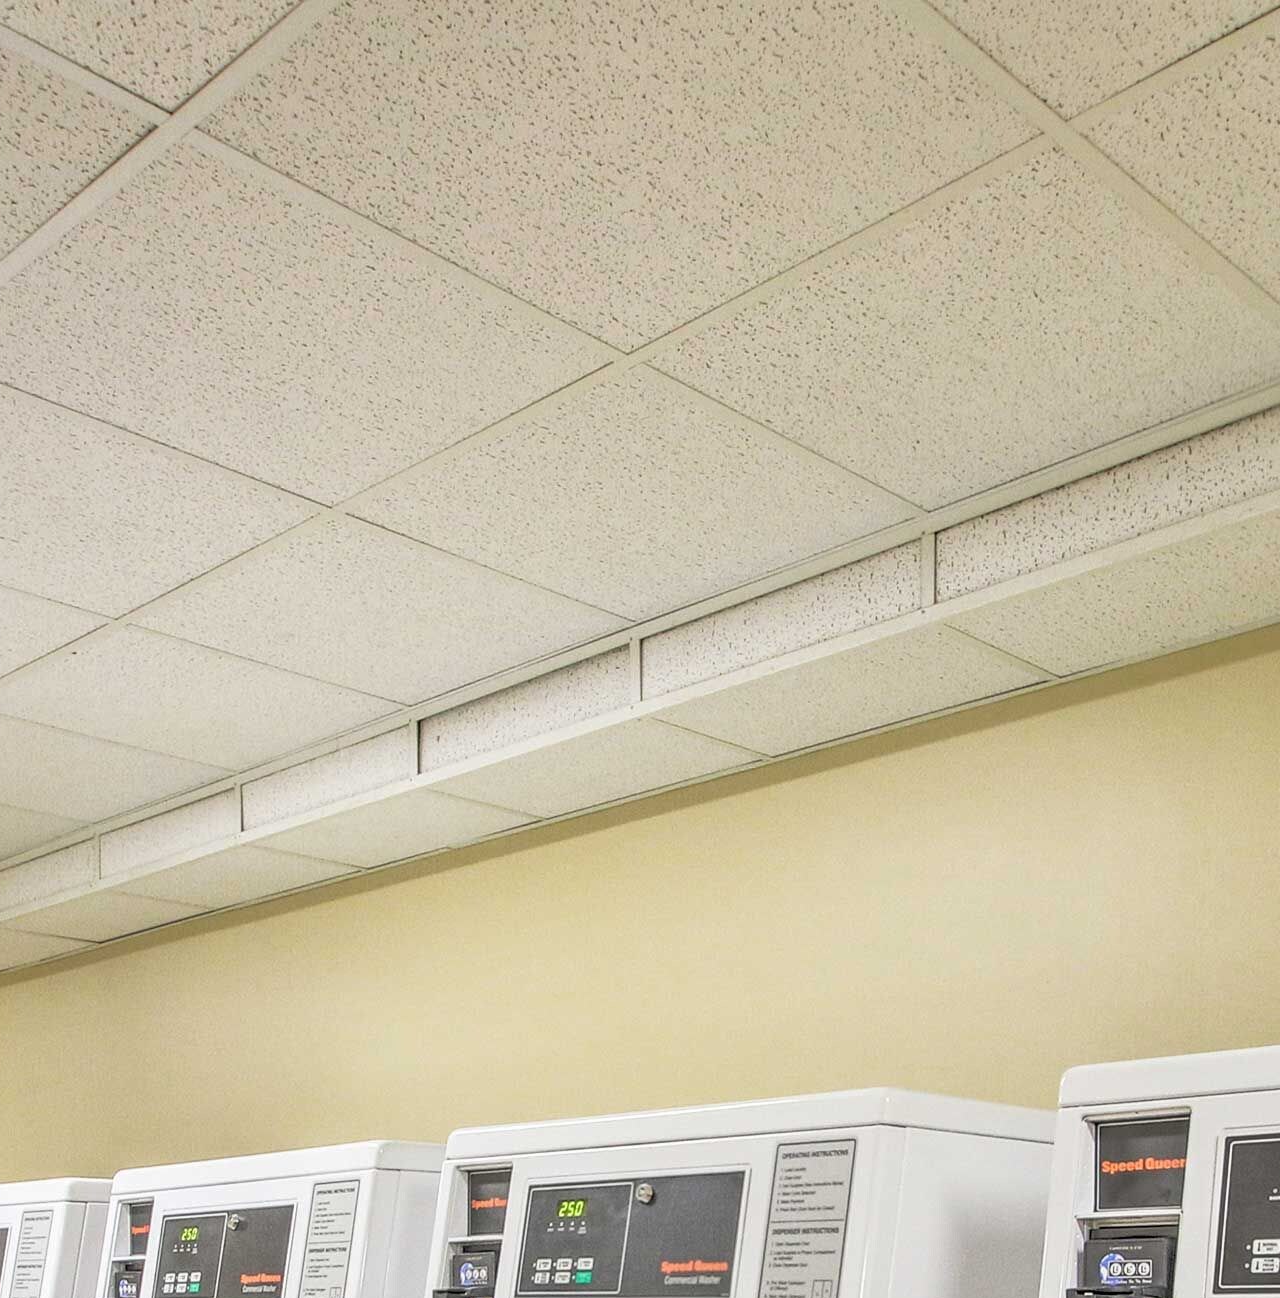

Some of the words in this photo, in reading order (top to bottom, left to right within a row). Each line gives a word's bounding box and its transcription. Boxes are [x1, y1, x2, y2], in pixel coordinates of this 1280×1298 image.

[1101, 1158, 1144, 1174] Speed
[472, 1197, 494, 1210] Speed
[558, 1201, 584, 1217] 250
[181, 1228, 198, 1240] 250
[661, 1260, 694, 1274] Speed
